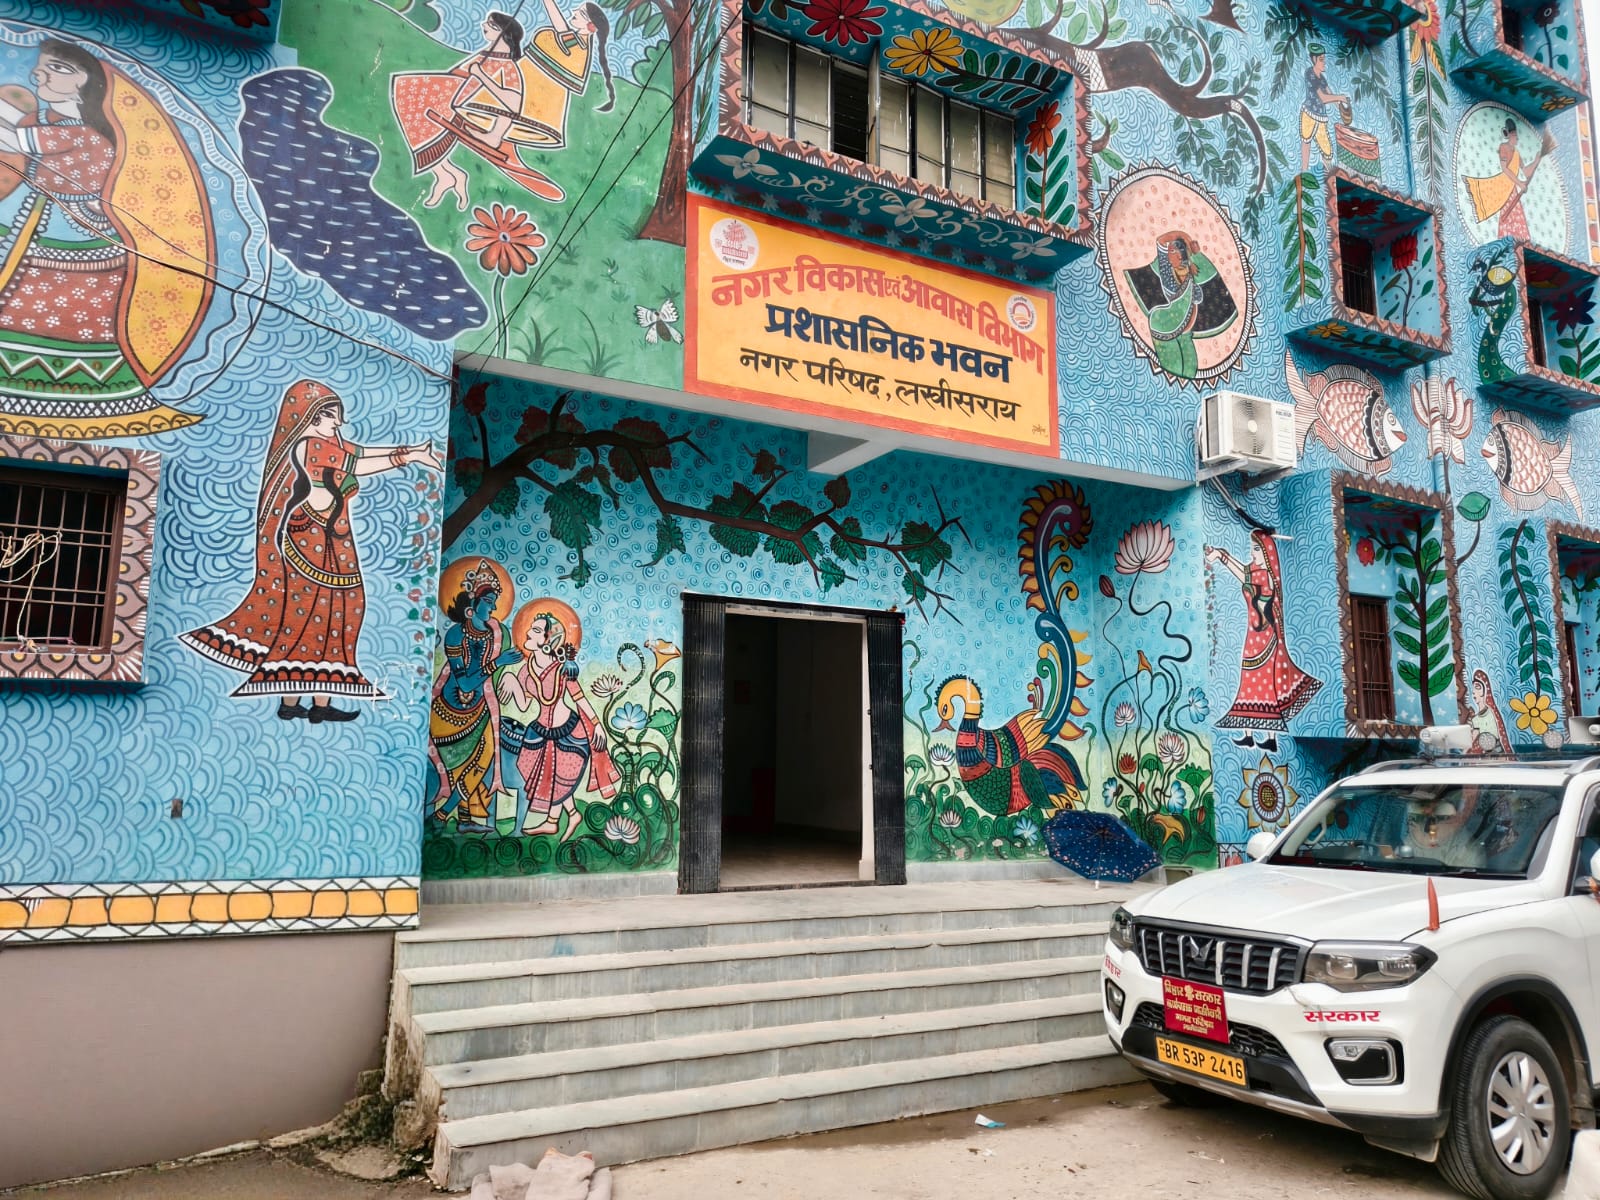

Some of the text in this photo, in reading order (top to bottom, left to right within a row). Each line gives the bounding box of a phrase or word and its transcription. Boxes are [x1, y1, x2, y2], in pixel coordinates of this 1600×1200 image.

[712, 266, 793, 306] नगर
[794, 255, 885, 297] विकास
[884, 276, 900, 299] एवं
[901, 275, 975, 330] आवास
[976, 301, 1046, 376] विभाग
[764, 303, 1013, 383] प्रशासनिक भवन
[740, 347, 799, 382] नगर
[894, 377, 1022, 421] लखीसराय
[1194, 989, 1222, 1005] सरकार
[1303, 1010, 1381, 1022] सरकार
[1165, 1043, 1243, 1079] BR 53P 2416
